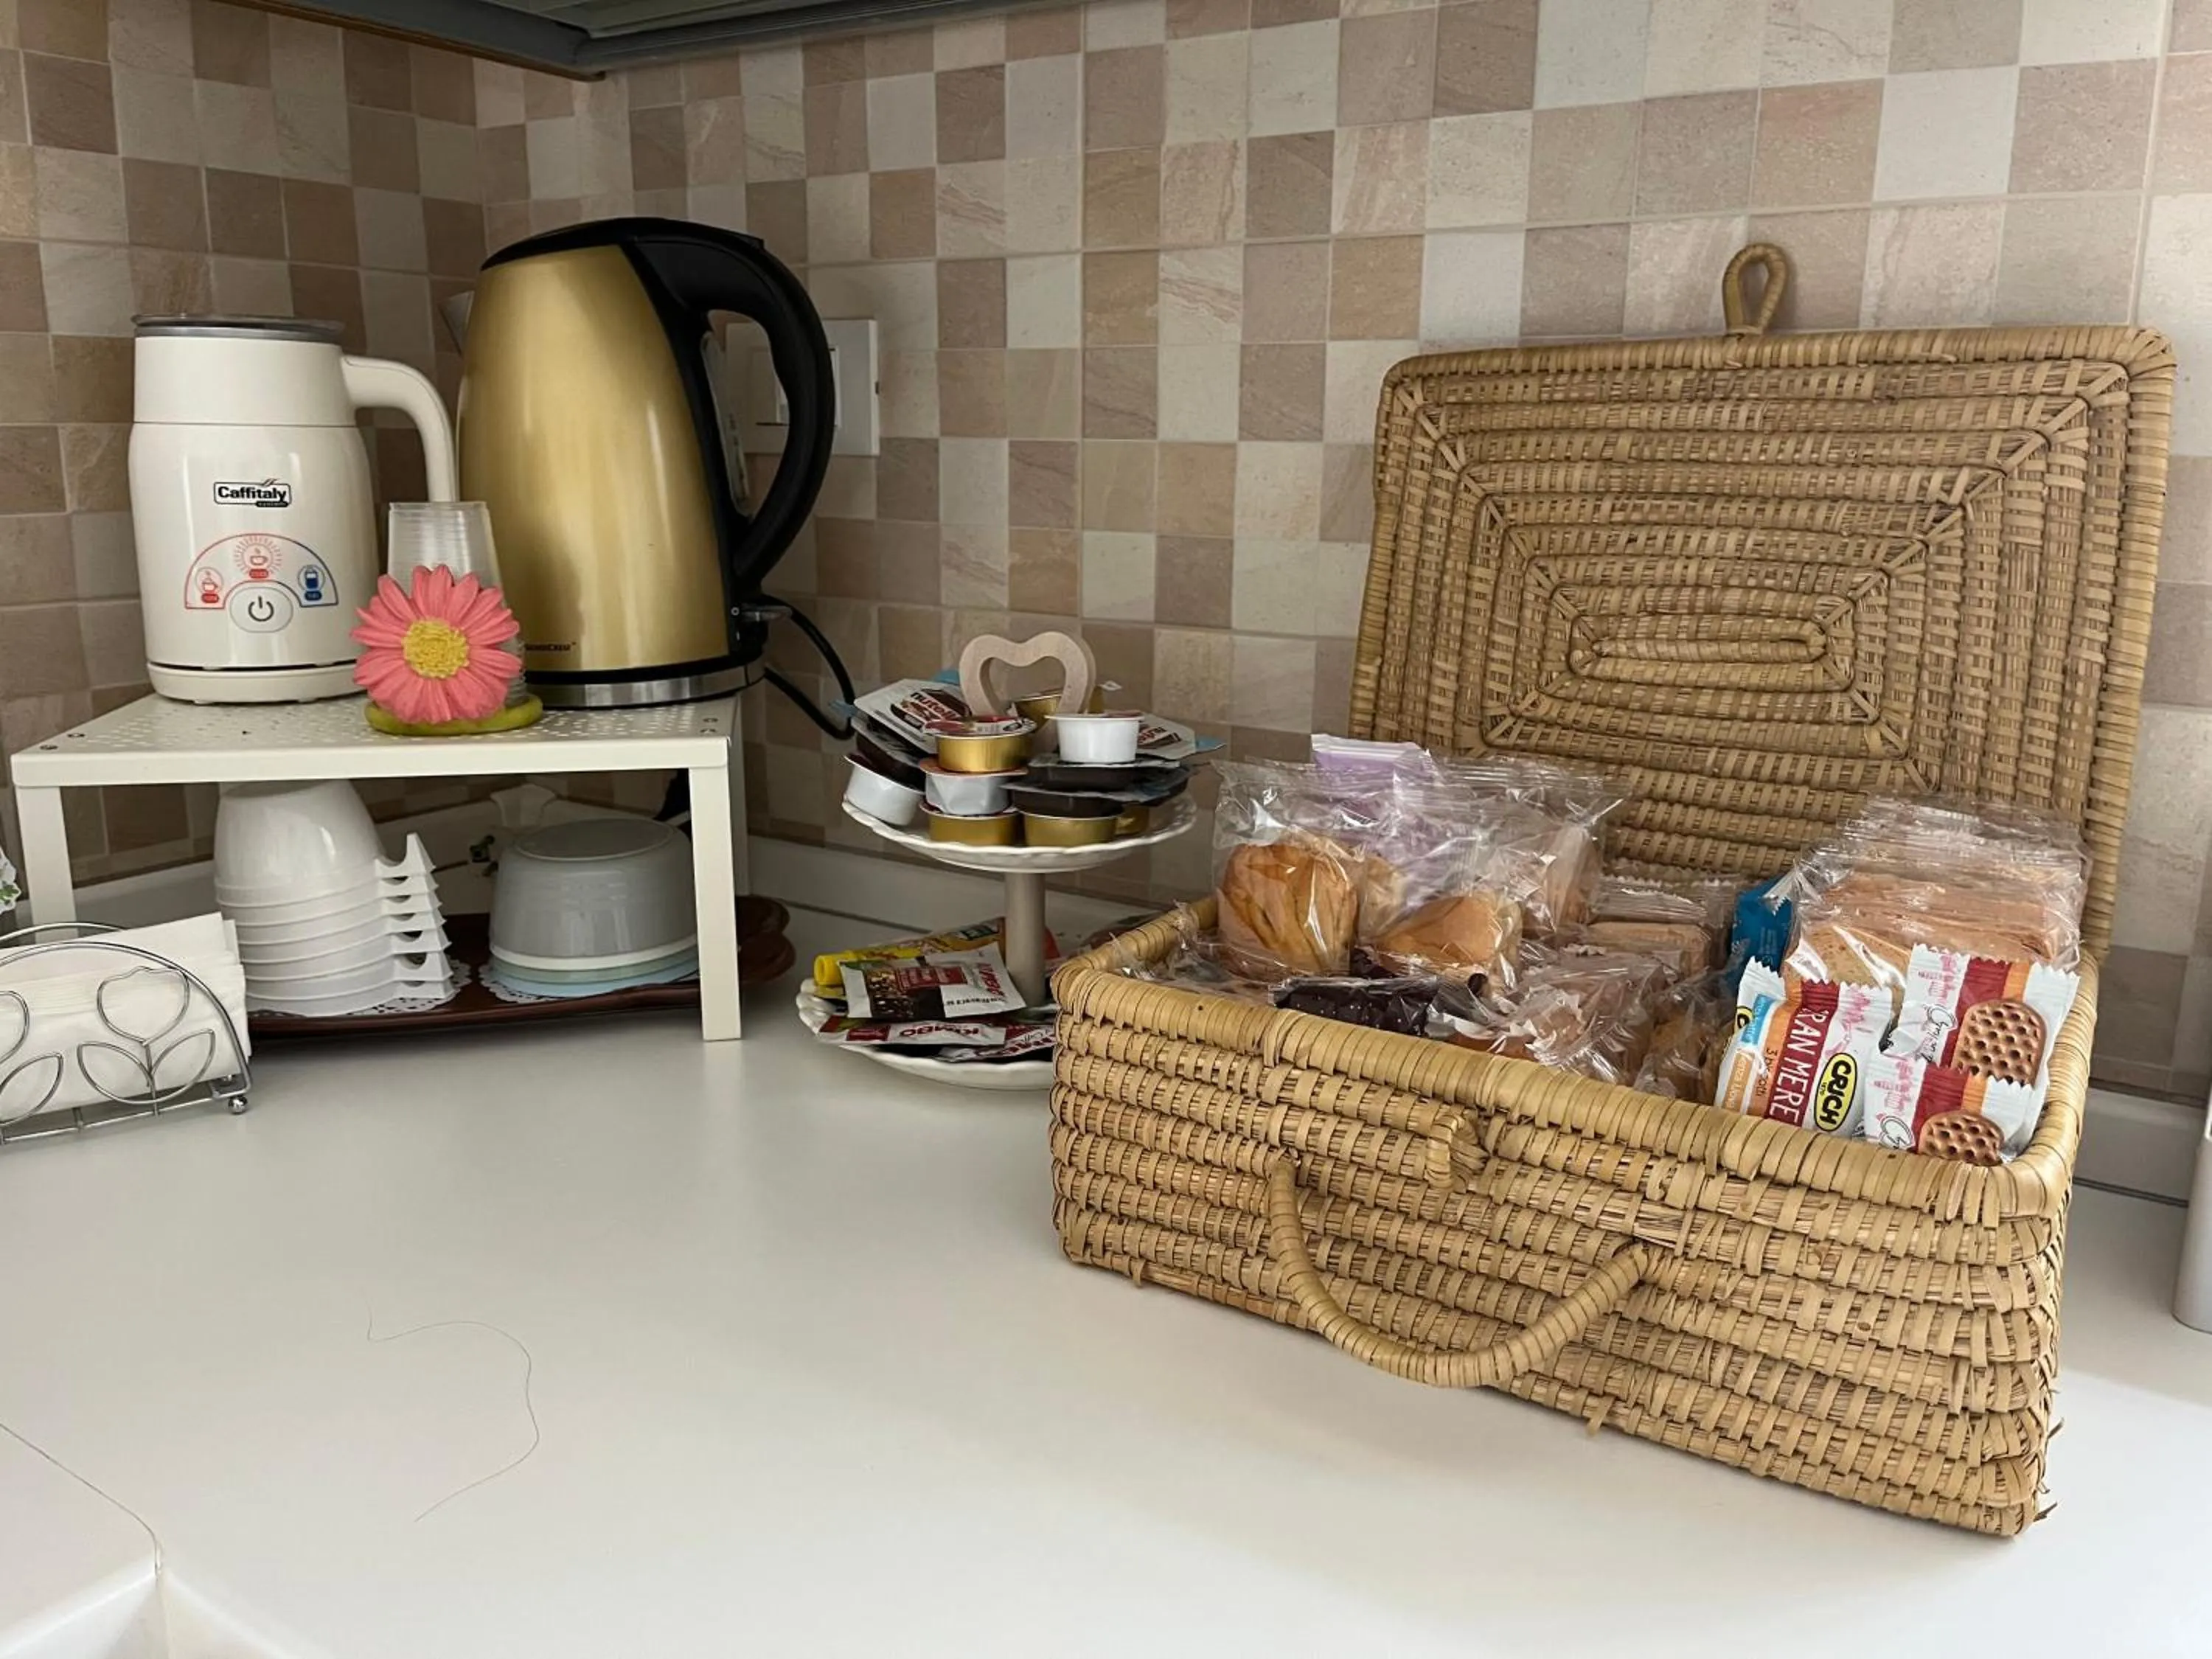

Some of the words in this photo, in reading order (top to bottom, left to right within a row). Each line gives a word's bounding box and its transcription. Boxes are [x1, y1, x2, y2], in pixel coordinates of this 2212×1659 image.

[218, 486, 286, 502] Caffitaly
[911, 692, 961, 721] nutell
[1787, 1007, 1829, 1055] RAN
[1819, 1060, 1851, 1124] CRICH
